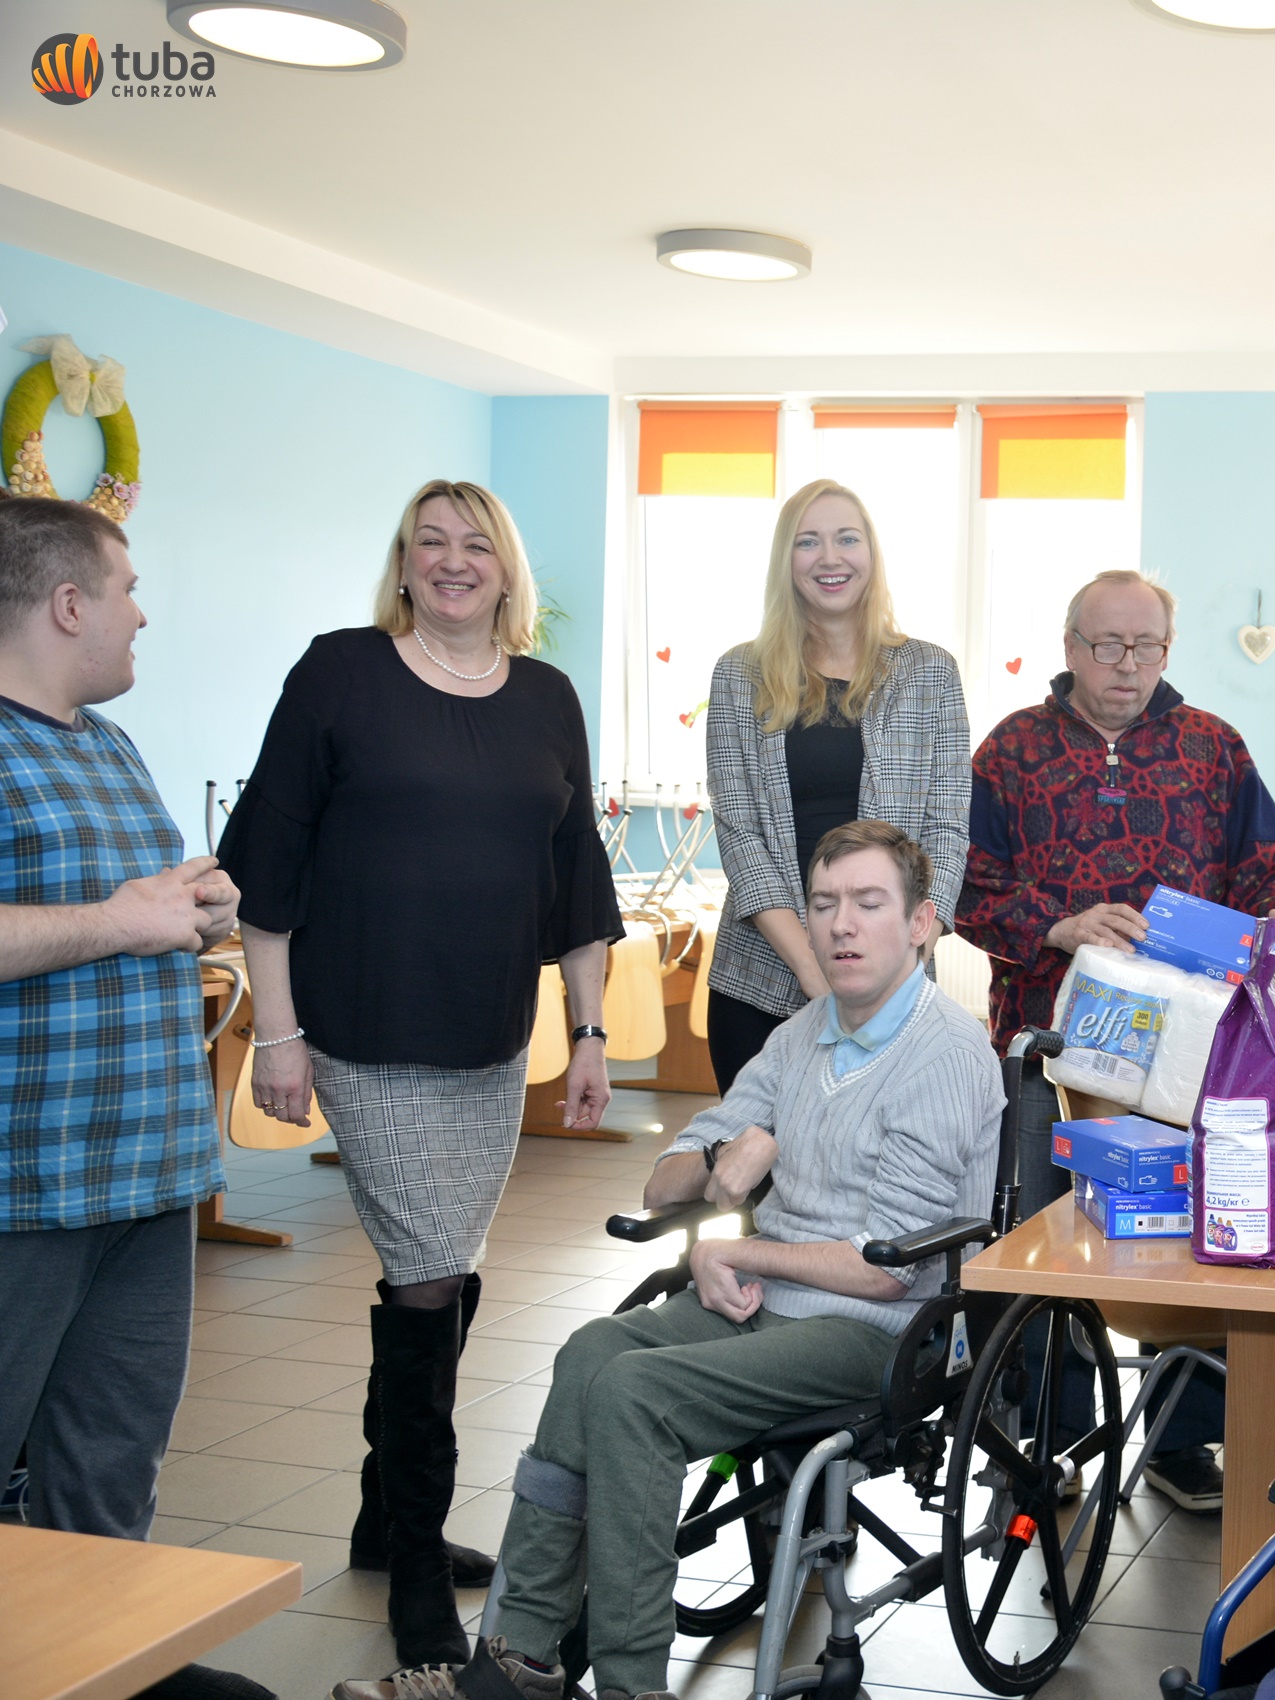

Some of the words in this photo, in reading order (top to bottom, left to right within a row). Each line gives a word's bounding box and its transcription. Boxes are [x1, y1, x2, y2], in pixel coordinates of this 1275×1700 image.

[1075, 977, 1113, 1002] MAXI
[1137, 1012, 1149, 1021] 300
[1076, 1006, 1130, 1046] elfi
[1139, 1154, 1159, 1163] nitrylex
[1178, 1169, 1184, 1180] L
[1206, 1196, 1217, 1206] 4,2
[1120, 1219, 1132, 1230] M
